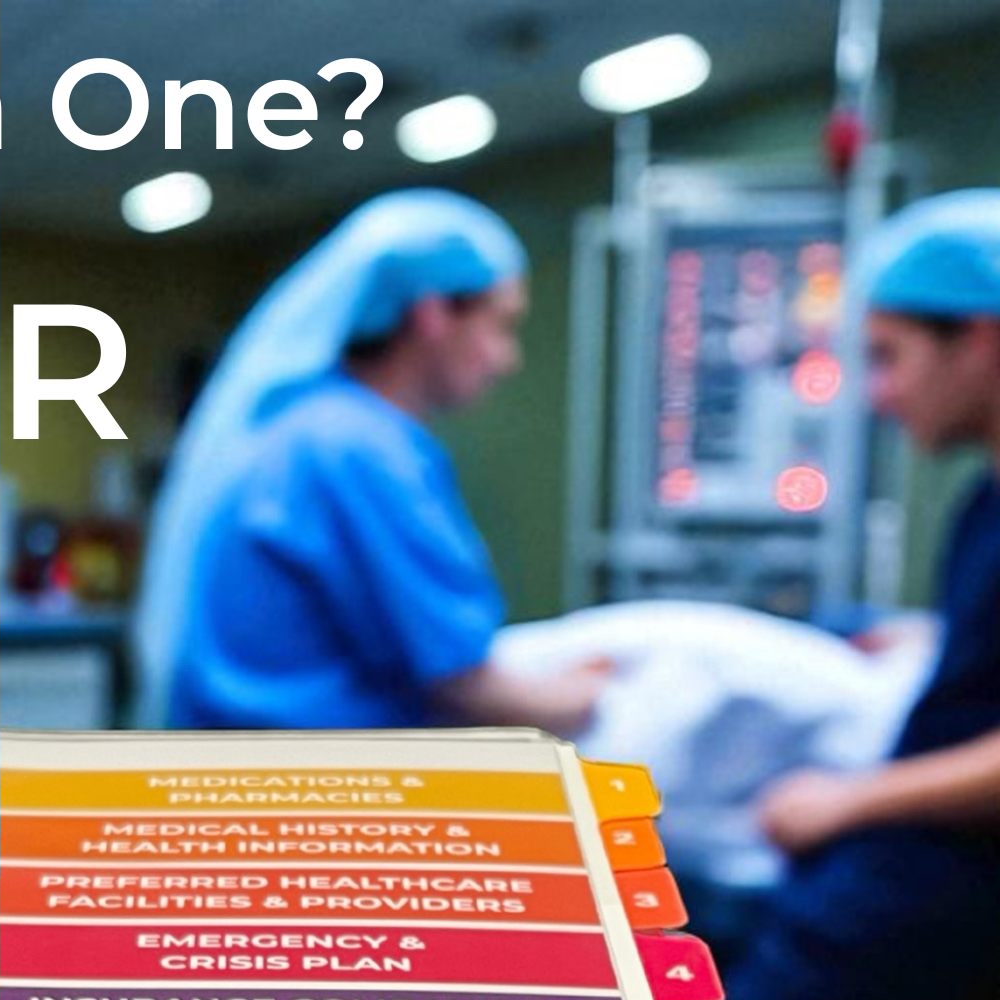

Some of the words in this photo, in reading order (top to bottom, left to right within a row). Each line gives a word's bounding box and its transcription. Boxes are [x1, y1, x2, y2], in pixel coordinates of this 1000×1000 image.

[147, 774, 391, 788] MEDICATIONS
[400, 773, 424, 788] &
[610, 778, 625, 792] 1
[168, 790, 404, 804] PHARMACIES
[102, 822, 269, 836] MEDICAL
[278, 822, 435, 837] HISTORY
[445, 823, 470, 837] &
[612, 830, 635, 845] 2
[81, 840, 226, 854] HEALTH
[237, 840, 501, 856] INFORMATION
[39, 874, 269, 889] PREFERRED
[280, 875, 533, 893] HEALTHCARE
[47, 894, 252, 909] FACILITIES
[262, 895, 289, 909] &
[300, 895, 526, 913] PROVIDERS
[633, 892, 660, 908] 3
[136, 933, 388, 949] EMERGENCY
[398, 935, 426, 950] &
[159, 954, 290, 970] CRISIS
[302, 955, 411, 972] PLAN
[665, 964, 695, 982] 4
